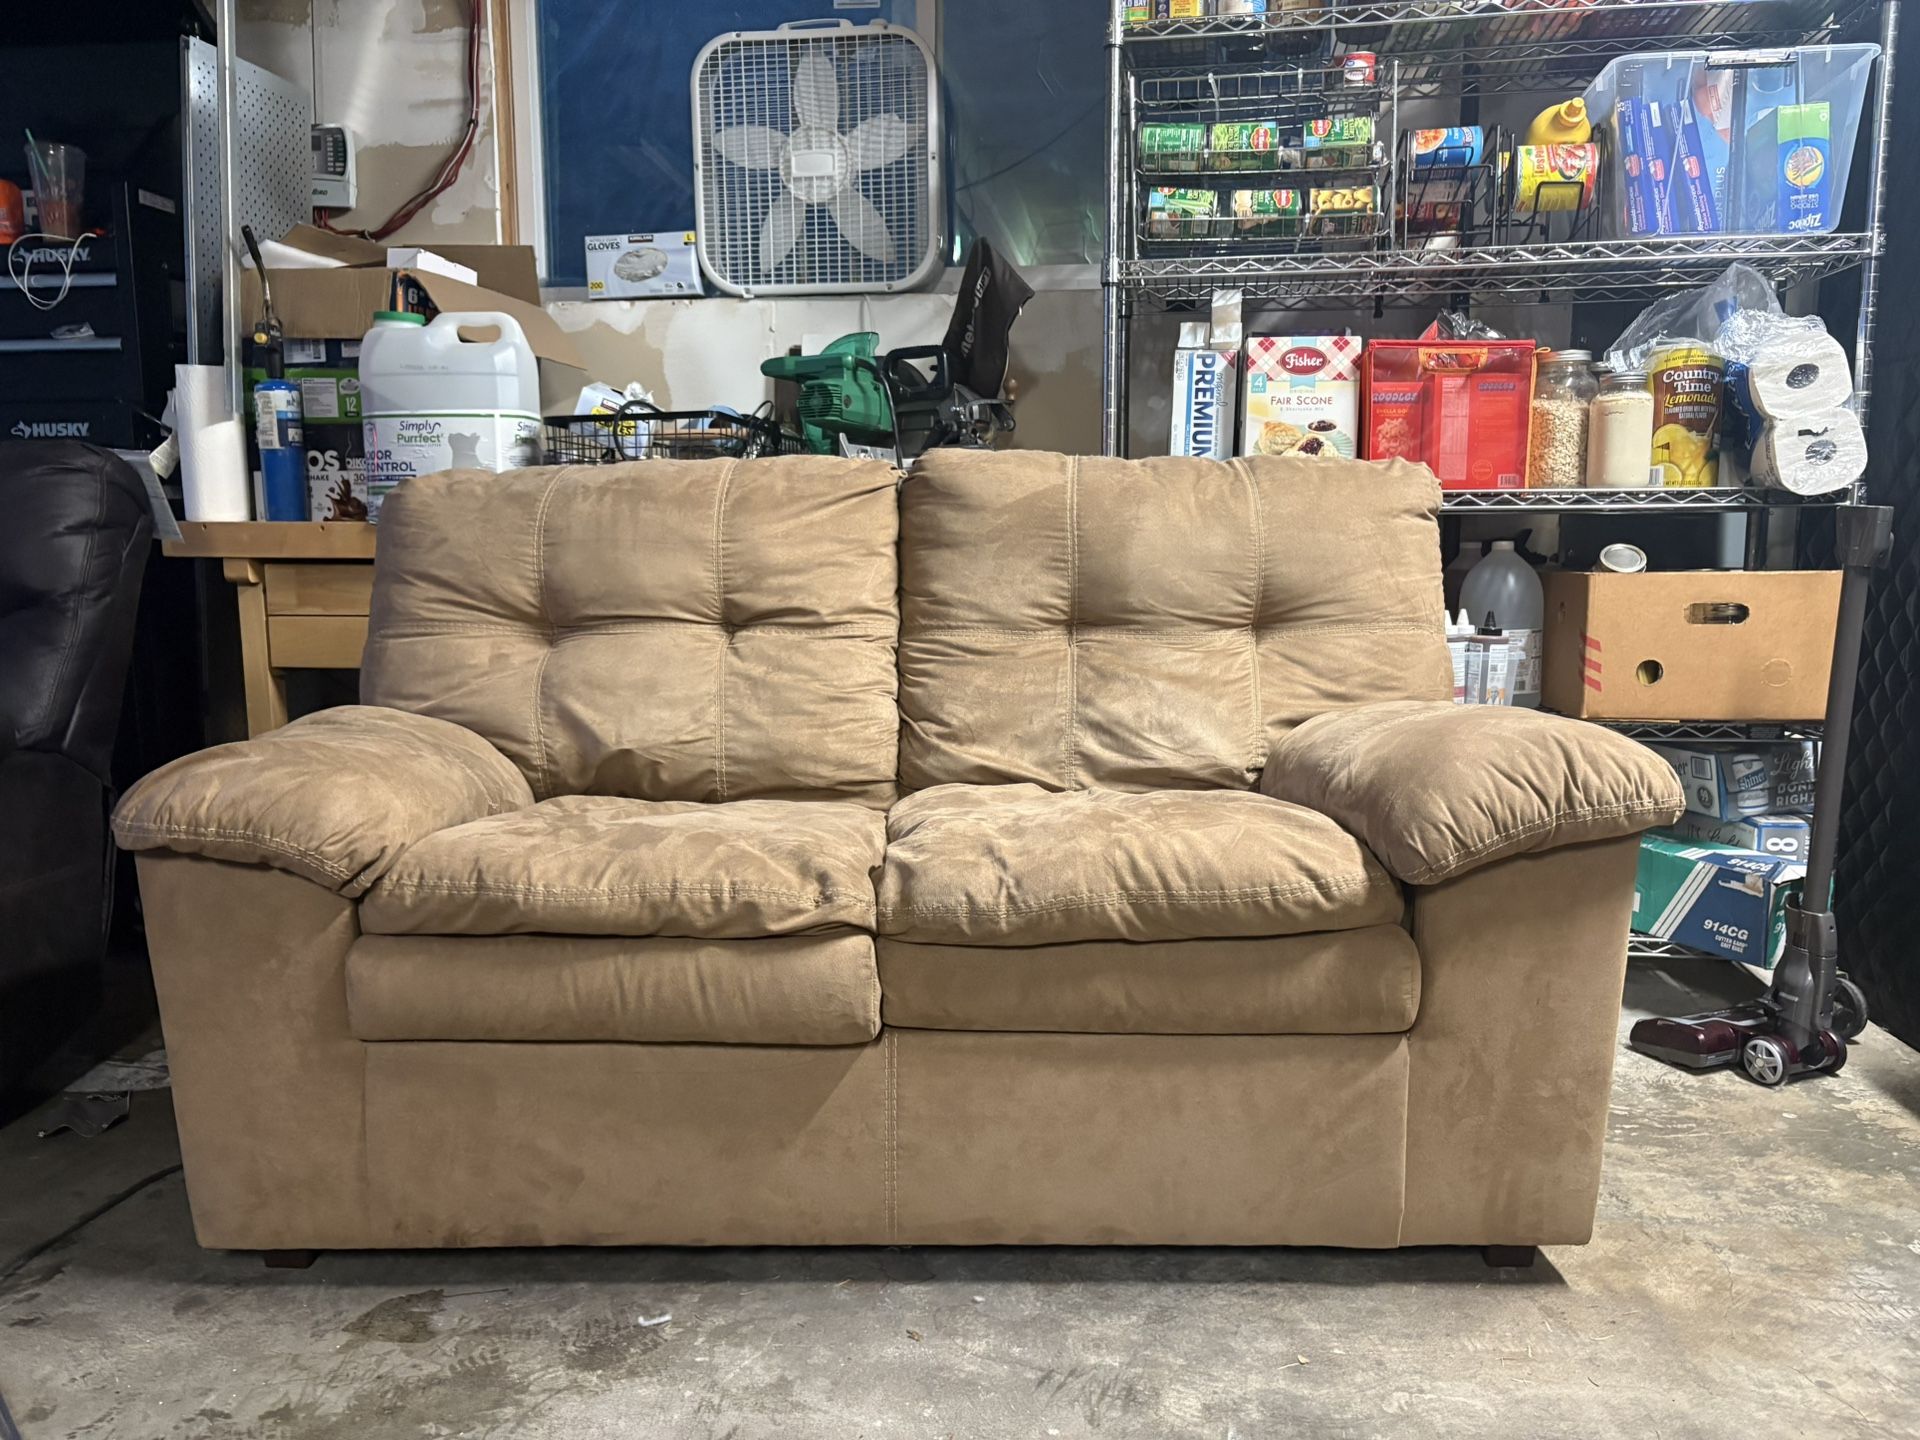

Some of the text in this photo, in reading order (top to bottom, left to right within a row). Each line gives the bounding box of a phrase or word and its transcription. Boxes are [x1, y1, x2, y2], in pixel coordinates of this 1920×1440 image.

[1715, 167, 1726, 198] PLUS
[587, 242, 620, 251] GLOVES
[33, 247, 90, 262] HUSKY
[590, 282, 604, 290] 200
[1285, 353, 1323, 368] Fisher
[1254, 376, 1263, 388] 4
[1662, 368, 1720, 384] Country
[1214, 372, 1228, 407] original
[1673, 380, 1711, 393] Time
[346, 397, 357, 412] 12
[1271, 396, 1333, 405] FAIR SCONE
[32, 422, 89, 437] HUSKY
[400, 420, 441, 434] Simply
[397, 433, 441, 443] Purrfect
[1771, 750, 1814, 780] Light
[1739, 771, 1765, 790] Shiner
[1776, 791, 1815, 807] RIGHT
[1727, 858, 1774, 871] 914CG
[1703, 919, 1749, 940] 914CG
